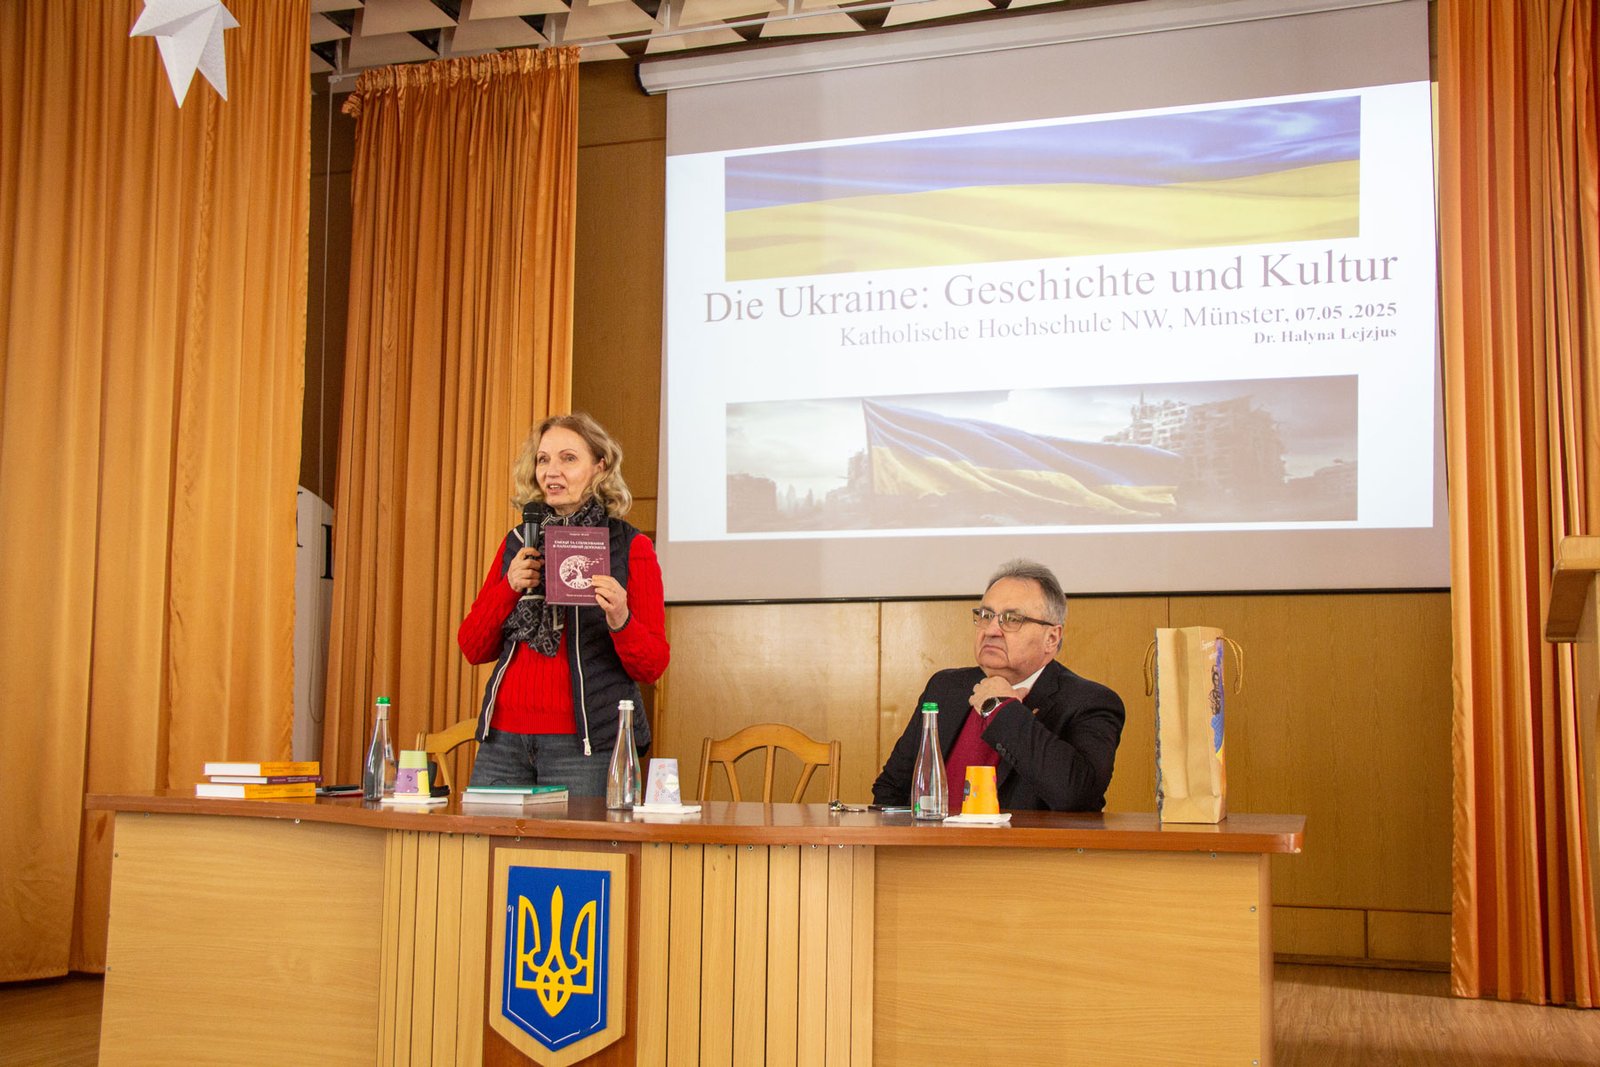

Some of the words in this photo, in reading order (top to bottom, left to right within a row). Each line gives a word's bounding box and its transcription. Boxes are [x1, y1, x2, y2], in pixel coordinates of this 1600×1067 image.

[703, 289, 764, 323] Die
[775, 280, 929, 318] Ukraine:
[944, 263, 1156, 307] Geschichte
[1169, 255, 1245, 294] und
[1259, 249, 1399, 288] Kultur
[840, 320, 969, 347] Katholische
[978, 312, 1112, 339] Hochschule
[1121, 308, 1174, 331] NW,
[1183, 306, 1290, 328] Münster,
[1253, 331, 1276, 345] Dr.
[1281, 329, 1335, 345] Halyna
[1340, 326, 1397, 343] Lejzjus
